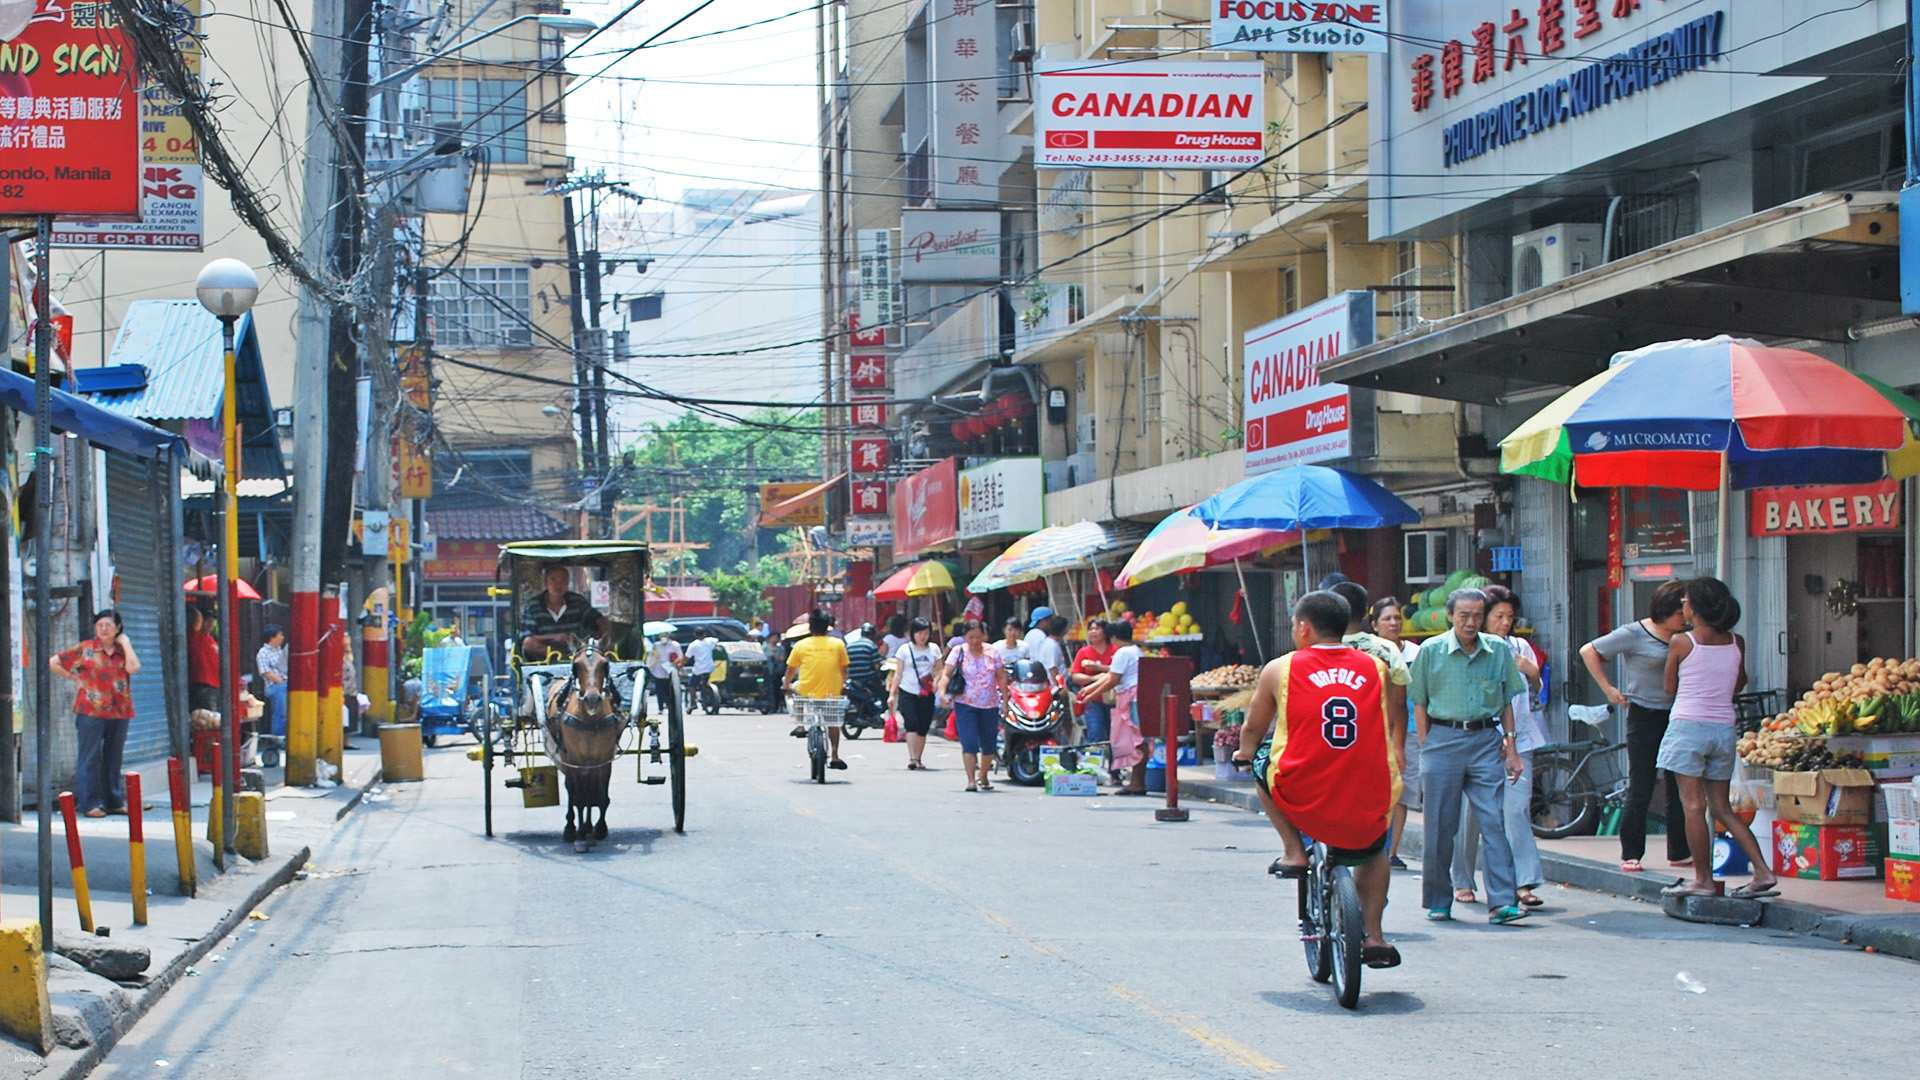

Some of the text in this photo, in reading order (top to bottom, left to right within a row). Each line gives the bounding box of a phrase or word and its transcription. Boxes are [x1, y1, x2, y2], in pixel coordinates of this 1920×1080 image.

[1219, 0, 1381, 23] FOCUS ZONE
[1234, 25, 1365, 45] Art Studio
[53, 43, 121, 76] SIGN
[1442, 94, 1527, 168] PHILIPPINE
[1600, 10, 1726, 105] FRATERNITY
[1051, 92, 1253, 118] CANADIAN
[55, 167, 112, 180] Manila
[103, 234, 147, 244] CD-R
[152, 235, 198, 245] KING
[1614, 432, 1712, 447] MICROMATIC
[1765, 492, 1897, 531] BAKERY
[1321, 696, 1358, 750] 8
